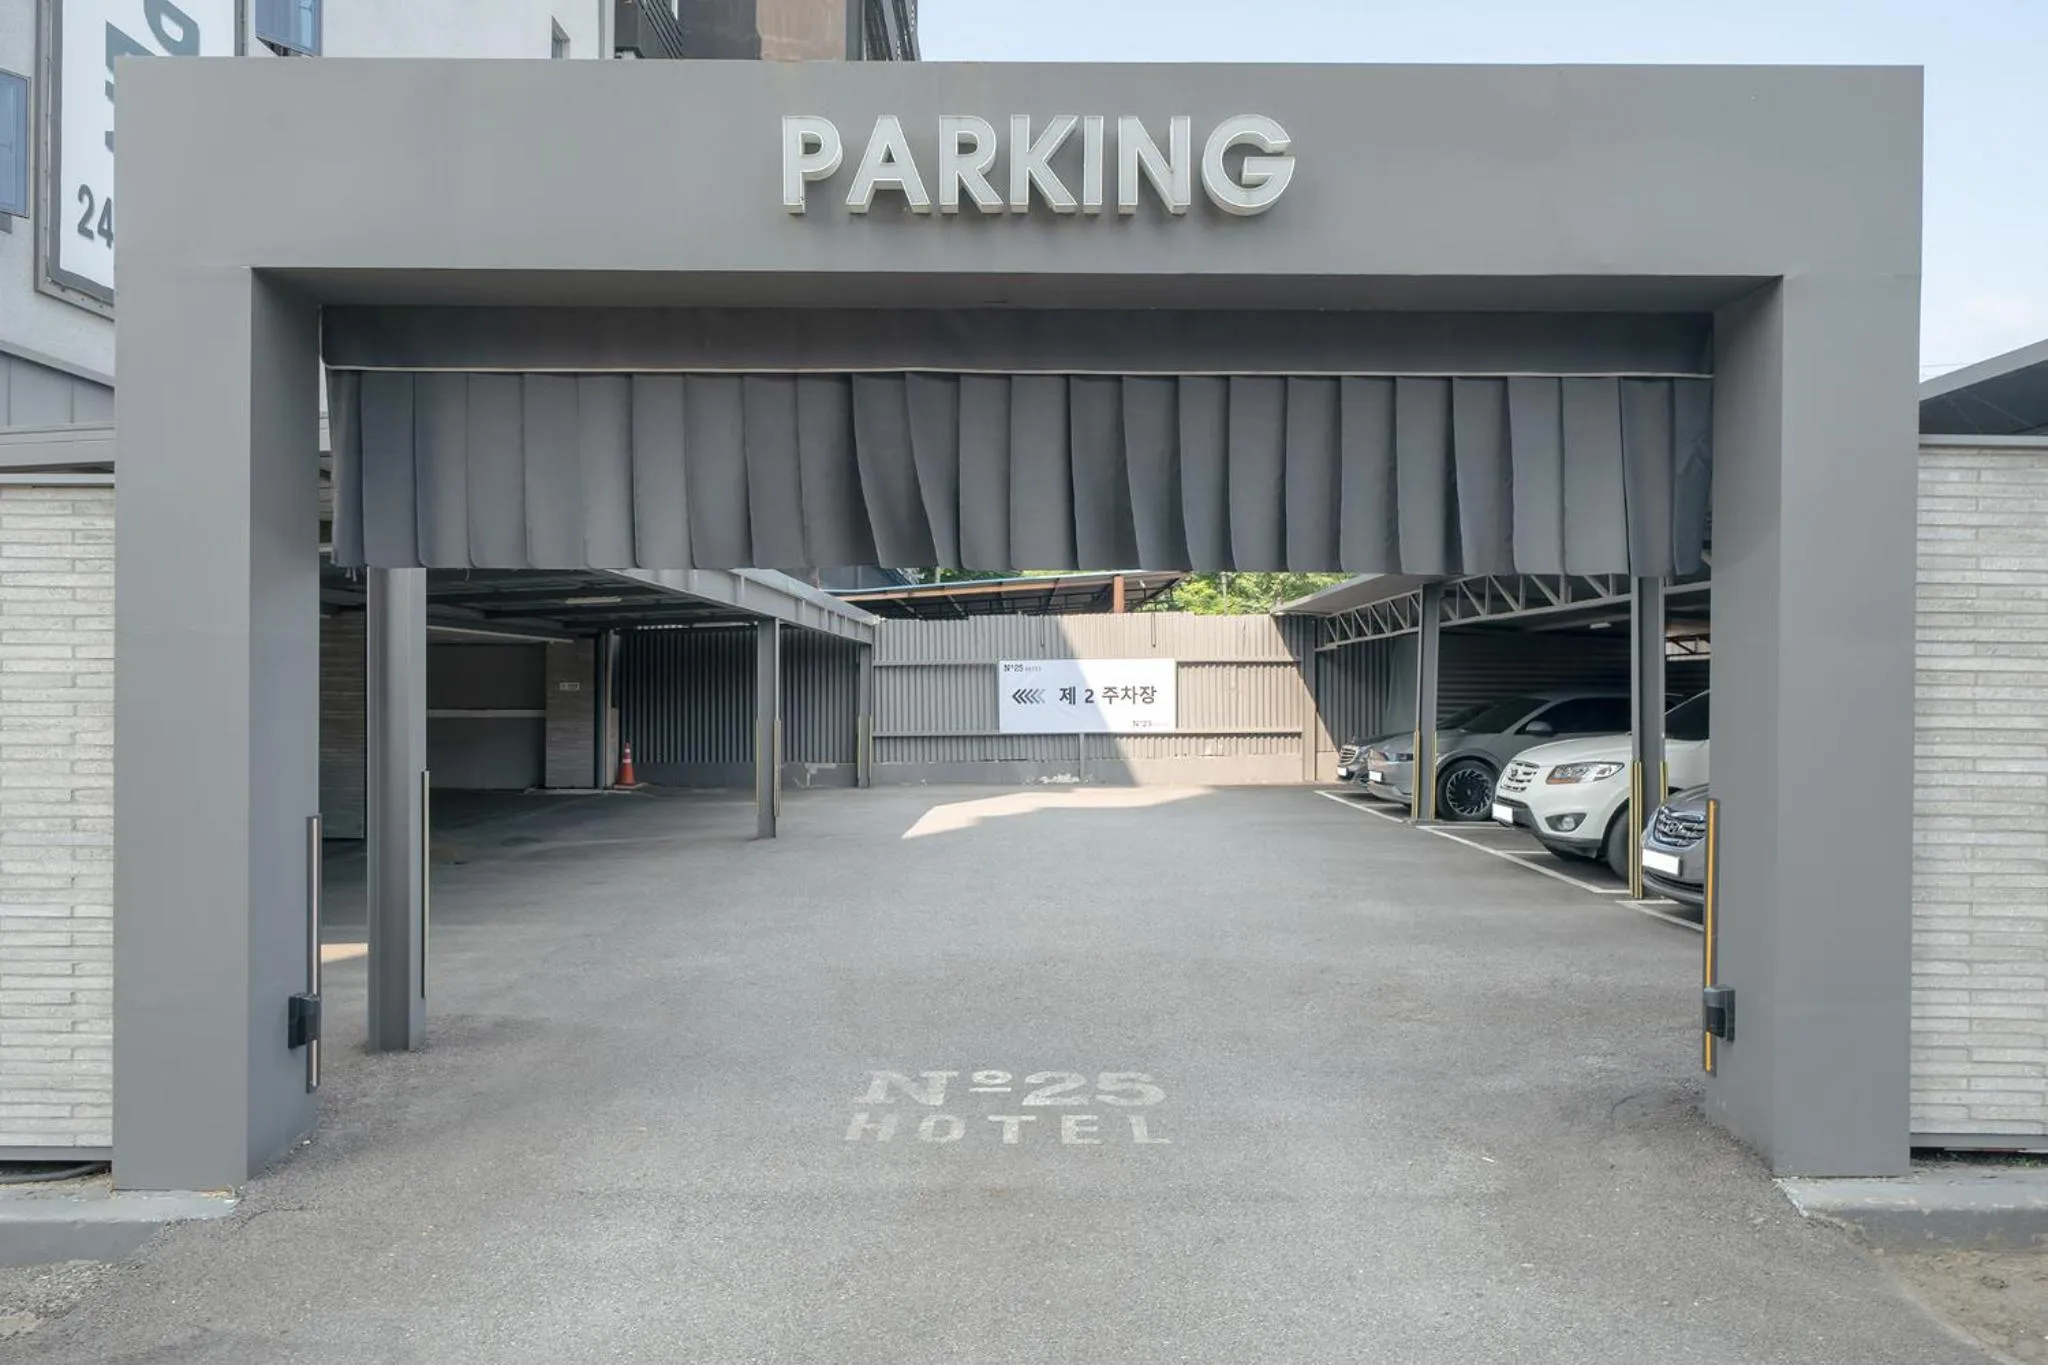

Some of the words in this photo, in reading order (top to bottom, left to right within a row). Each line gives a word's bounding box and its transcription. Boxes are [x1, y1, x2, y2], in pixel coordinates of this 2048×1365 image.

[782, 114, 1296, 216] PARKING
[1058, 686, 1076, 705] 제
[1084, 688, 1095, 704] 2
[1102, 685, 1157, 705] 주차장
[844, 1113, 1171, 1144] HOTEL
